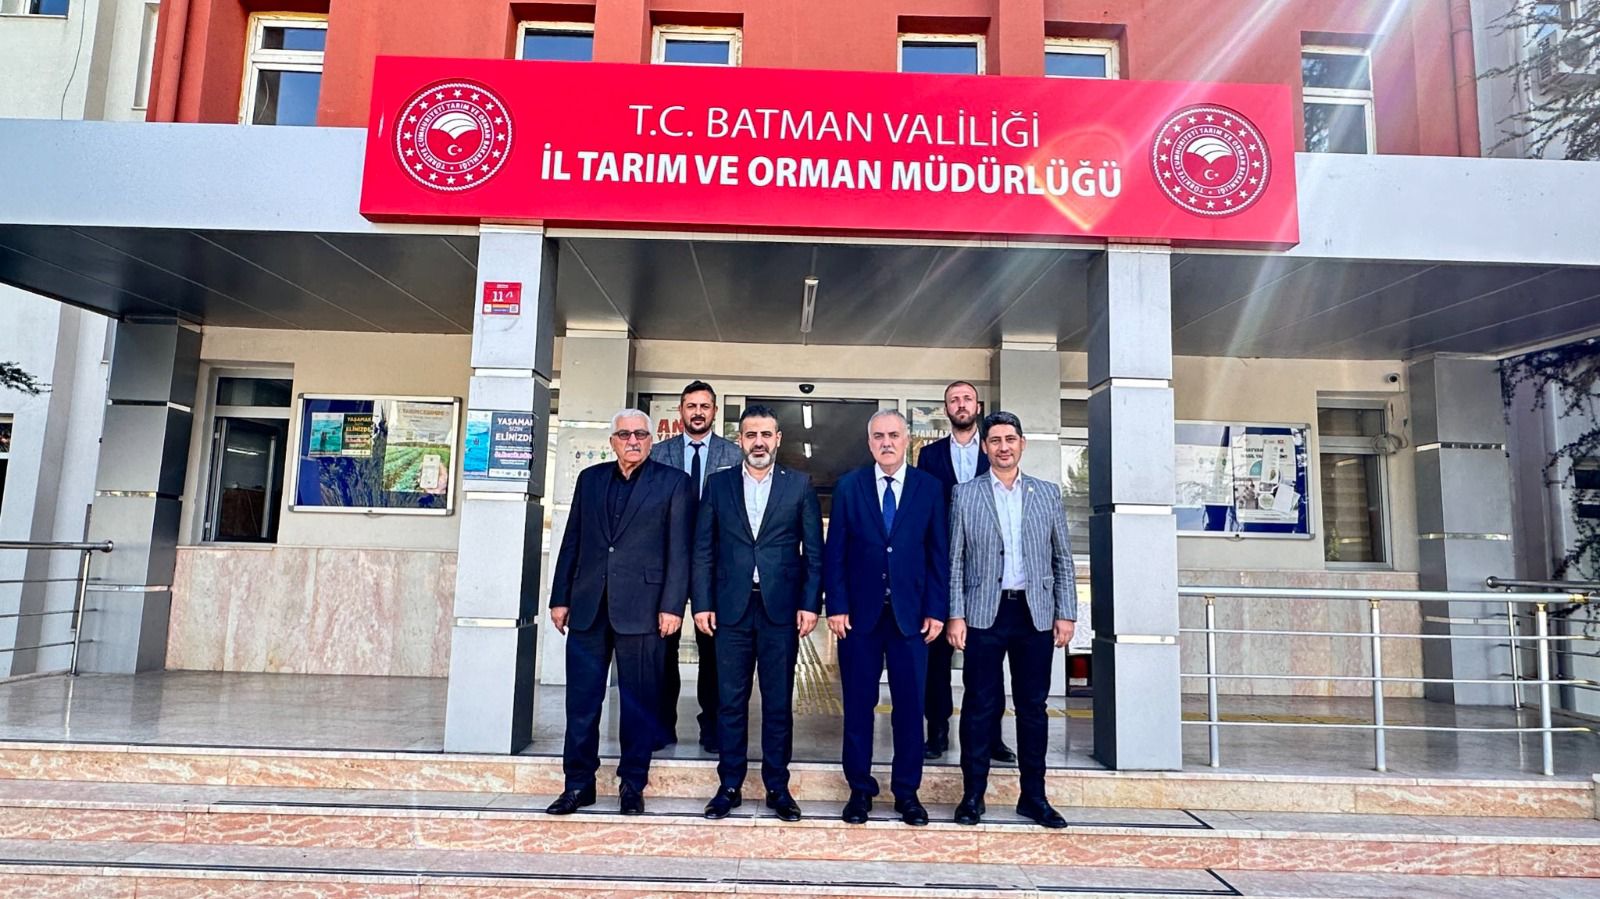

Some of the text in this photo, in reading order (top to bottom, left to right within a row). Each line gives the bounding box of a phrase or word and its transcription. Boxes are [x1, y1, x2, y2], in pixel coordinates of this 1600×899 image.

[446, 103, 470, 111] TARIM
[470, 107, 479, 117] VE
[478, 114, 492, 139] ORMAN
[629, 104, 1039, 148] T.C. BATMAN VALİLİĞİ
[1199, 127, 1222, 136] TARIM
[1223, 133, 1232, 142] VE
[1231, 140, 1246, 166] ORMAN
[541, 142, 1123, 198] İL TARIM VE ORMAN MÜDÜRLÜĞÜ
